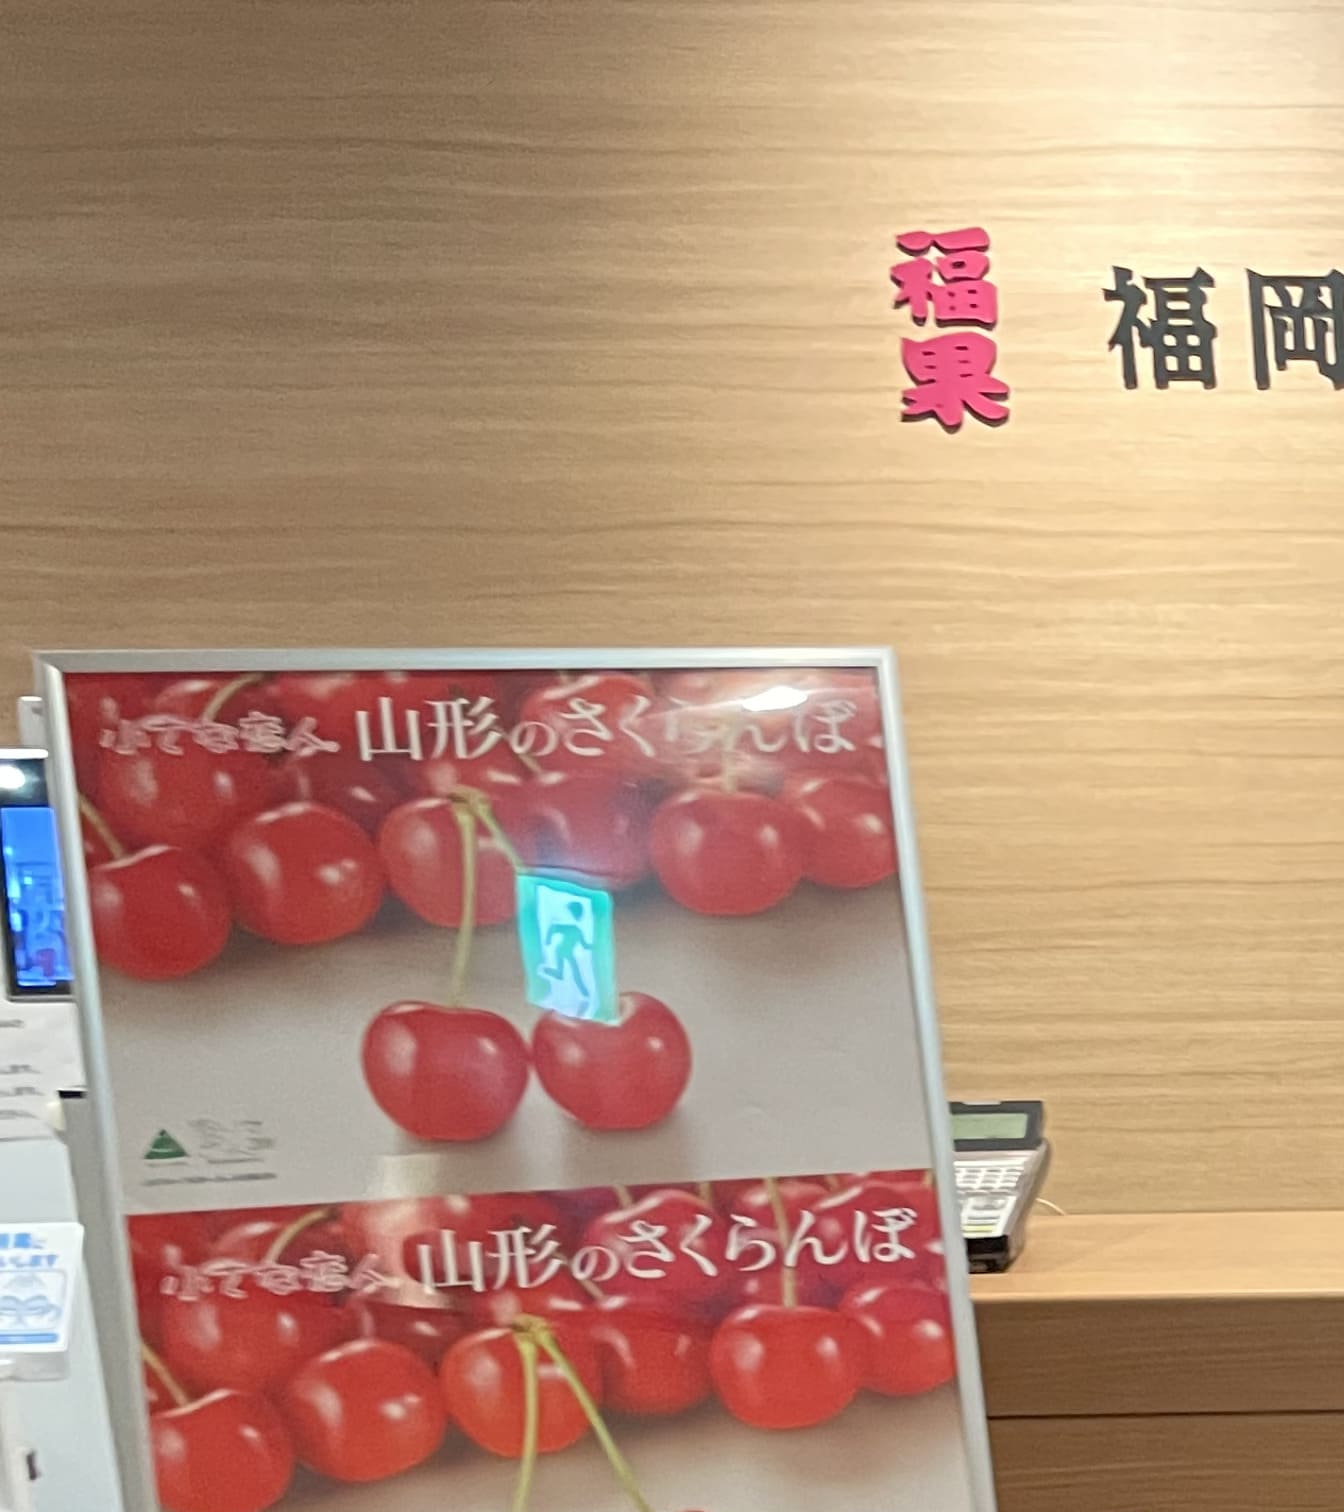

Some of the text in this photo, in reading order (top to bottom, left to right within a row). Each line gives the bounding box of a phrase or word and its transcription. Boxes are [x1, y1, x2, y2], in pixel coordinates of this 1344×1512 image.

[890, 226, 1011, 432] 福果
[355, 695, 857, 761] 山形のさくらんぼ
[416, 1206, 919, 1295] 山形のさくらんぼ
